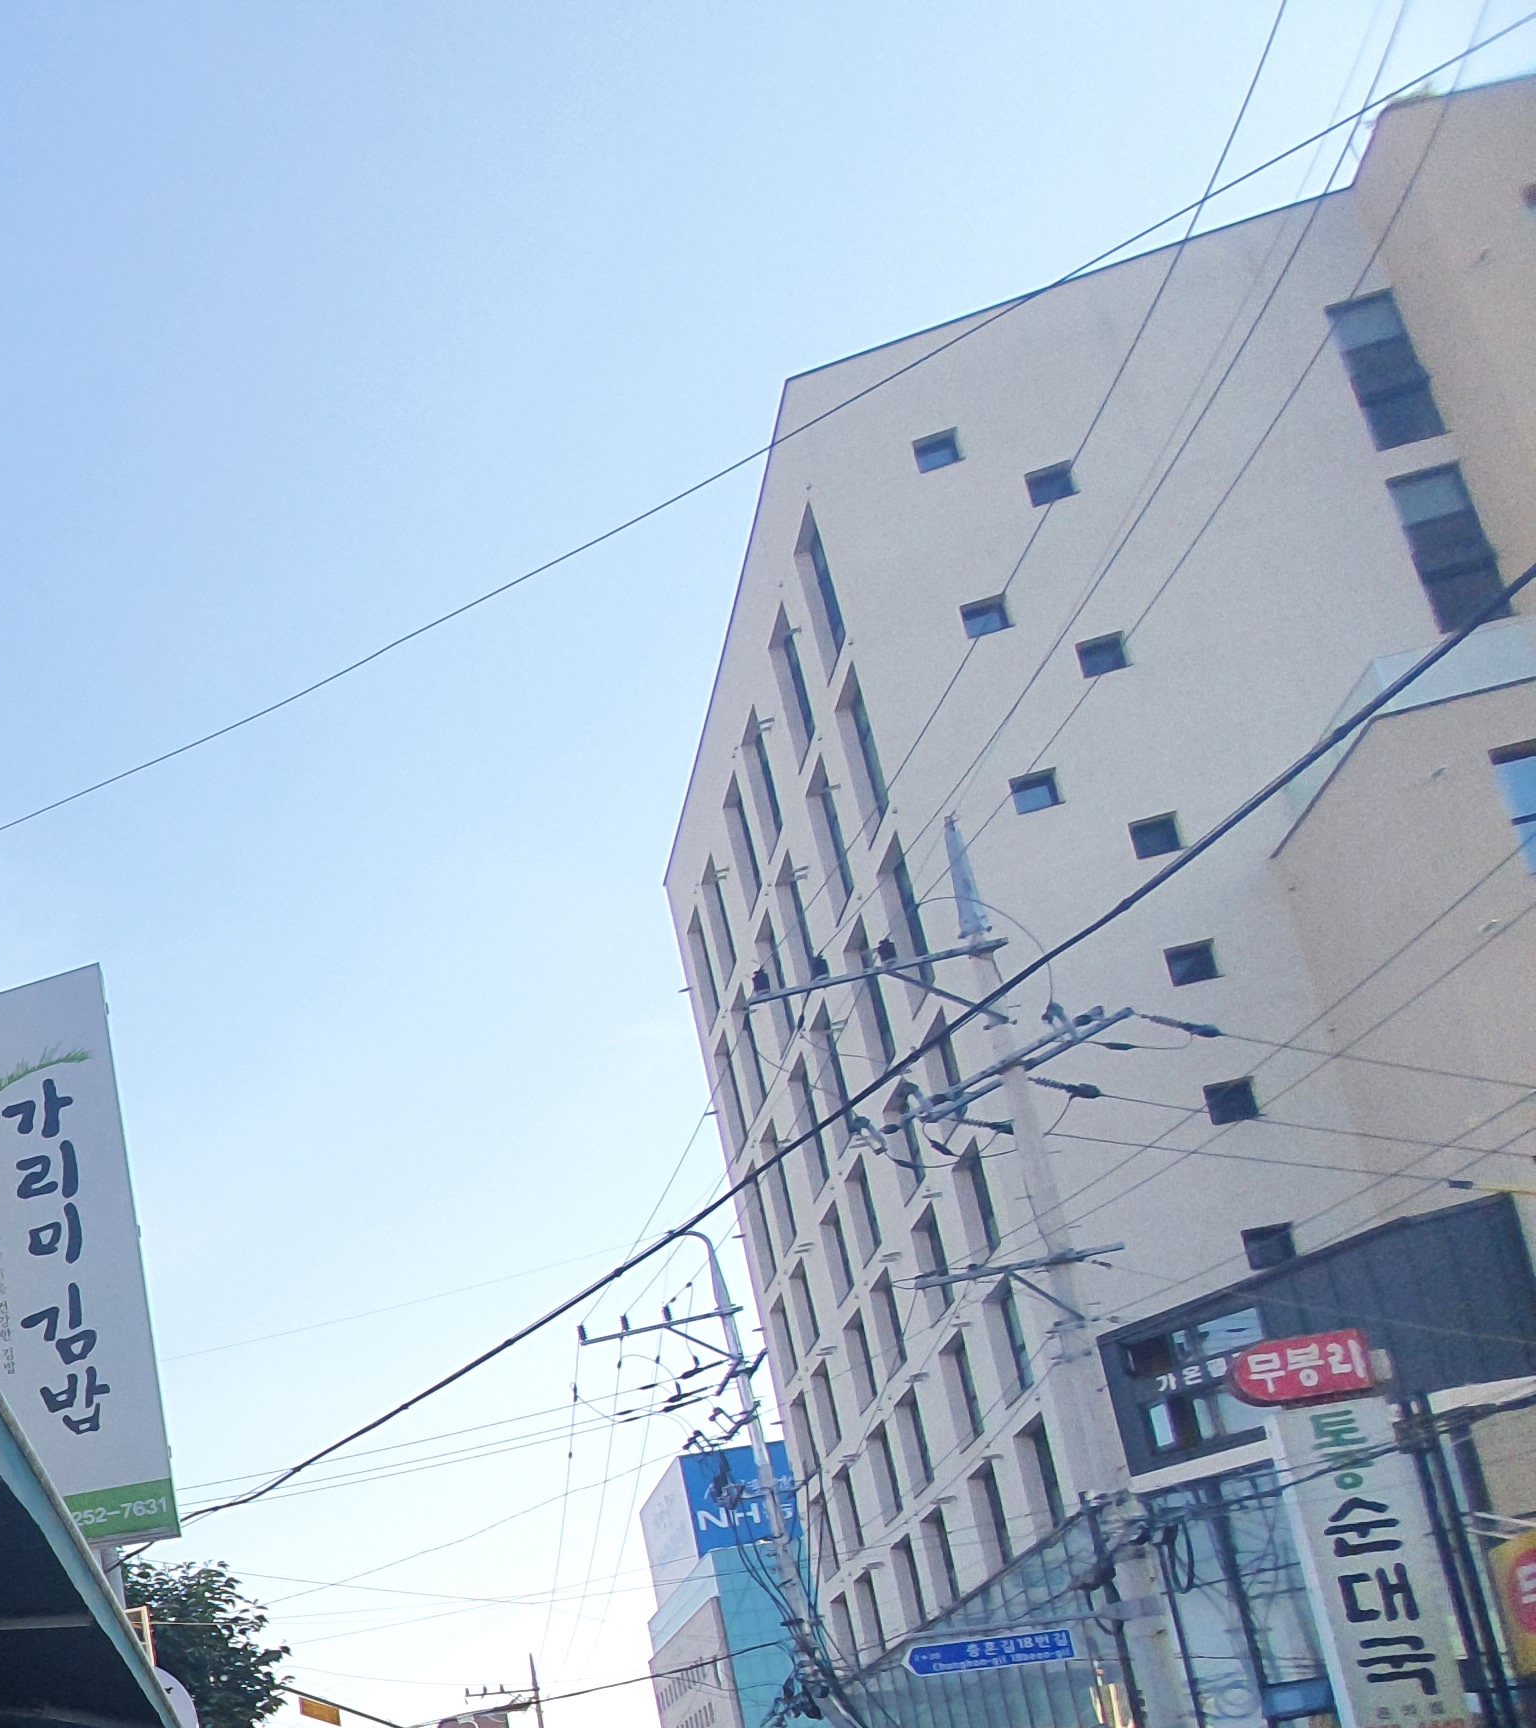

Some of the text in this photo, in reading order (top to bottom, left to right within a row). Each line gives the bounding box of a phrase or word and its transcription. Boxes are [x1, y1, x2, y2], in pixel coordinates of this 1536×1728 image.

[1, 1077, 111, 1435] 가리미 김밥
[1247, 1339, 1366, 1394] 무봉리
